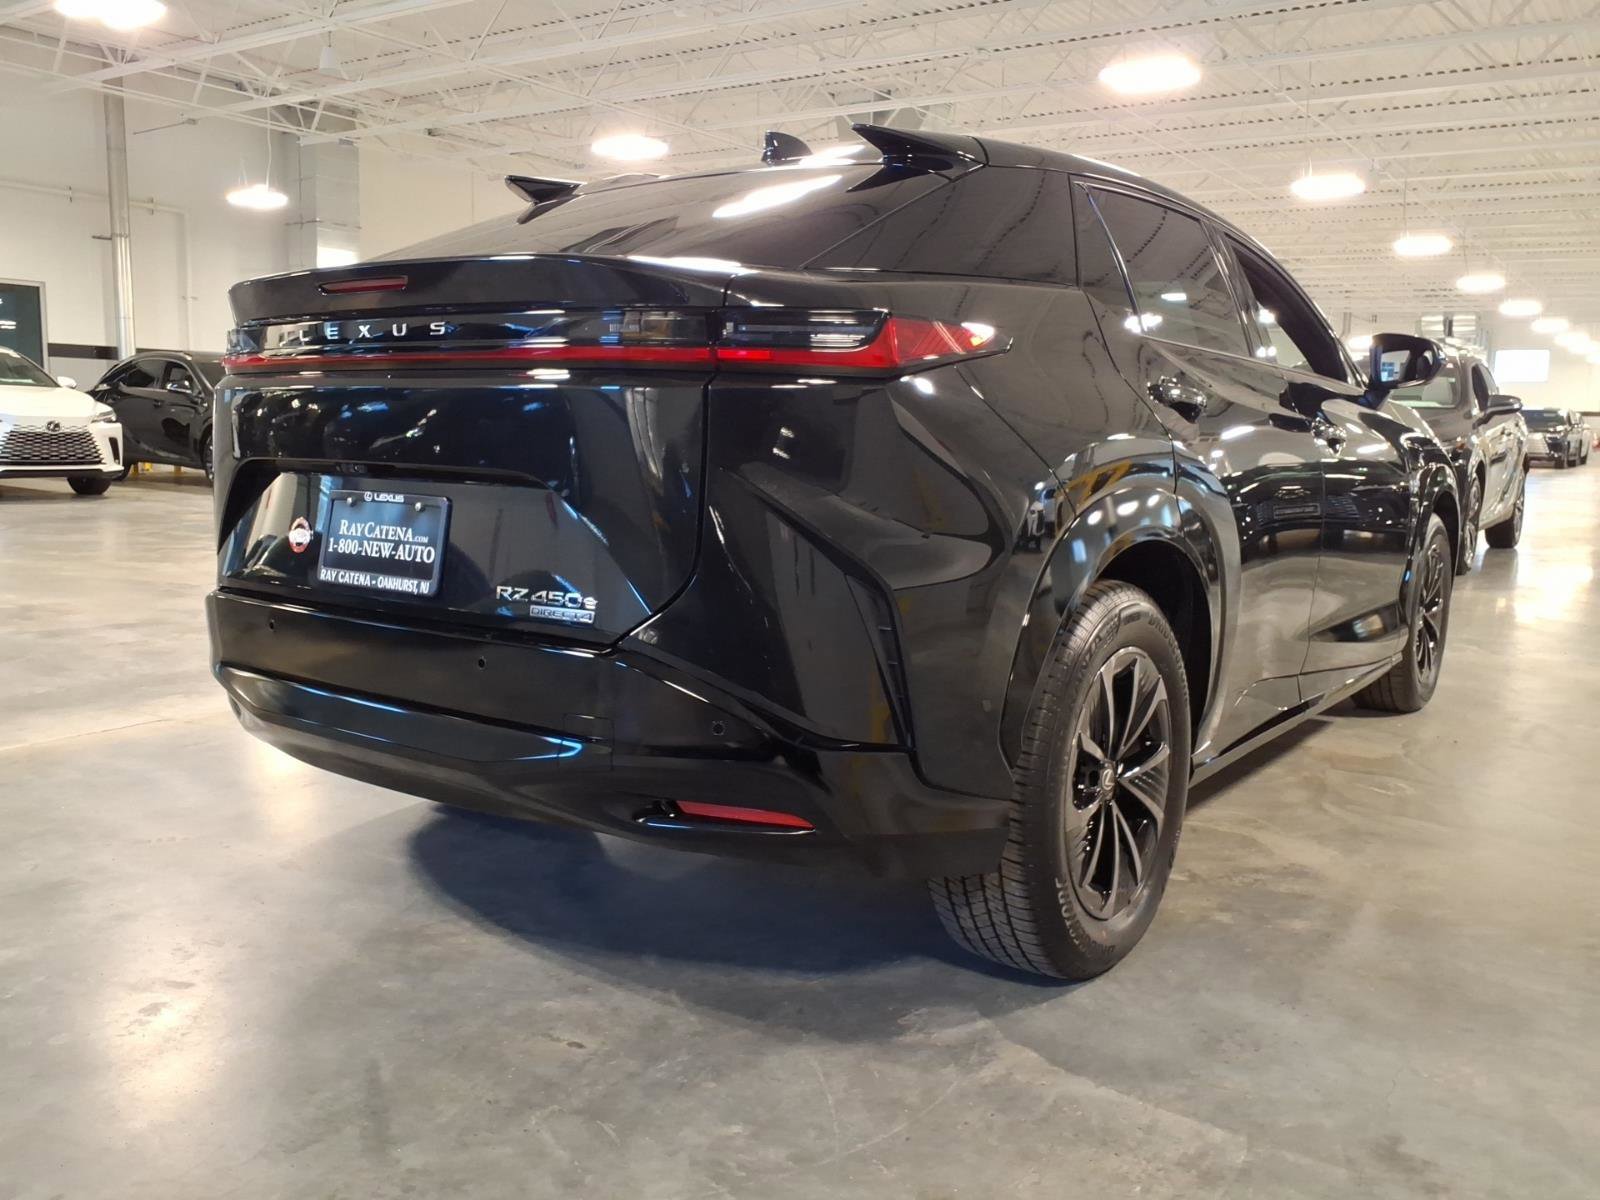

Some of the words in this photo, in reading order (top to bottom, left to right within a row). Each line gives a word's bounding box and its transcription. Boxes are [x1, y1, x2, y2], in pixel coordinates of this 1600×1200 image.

[299, 321, 446, 342] LEXUS
[374, 492, 405, 503] LEXUS
[327, 537, 436, 563] 1-800-NEW-AUTO
[319, 569, 337, 582] RAY
[338, 573, 371, 586] CATENA
[377, 576, 419, 595] OAKHURST,
[419, 582, 430, 594] NJ
[496, 585, 529, 602] RZ
[530, 590, 598, 610] 450e
[531, 606, 593, 623] DIRECT4
